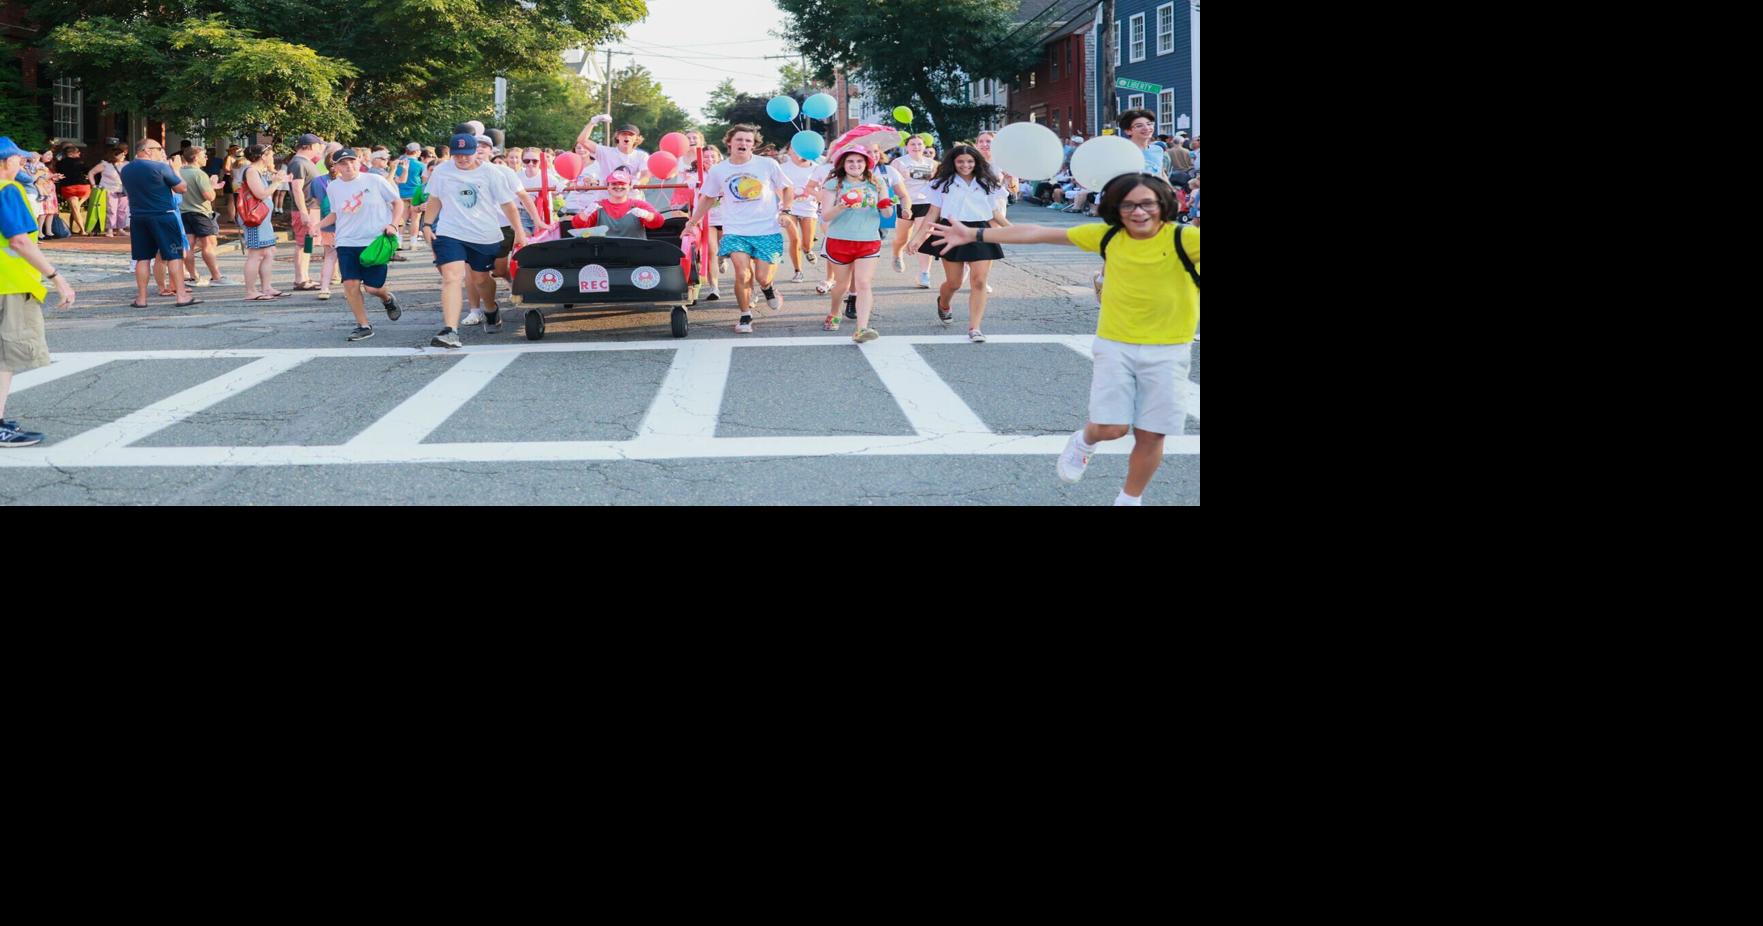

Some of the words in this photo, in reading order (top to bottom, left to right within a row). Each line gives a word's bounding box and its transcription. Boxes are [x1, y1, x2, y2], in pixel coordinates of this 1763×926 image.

[1127, 80, 1152, 91] LIBERTY
[458, 138, 466, 148] B
[580, 280, 607, 289] REC
